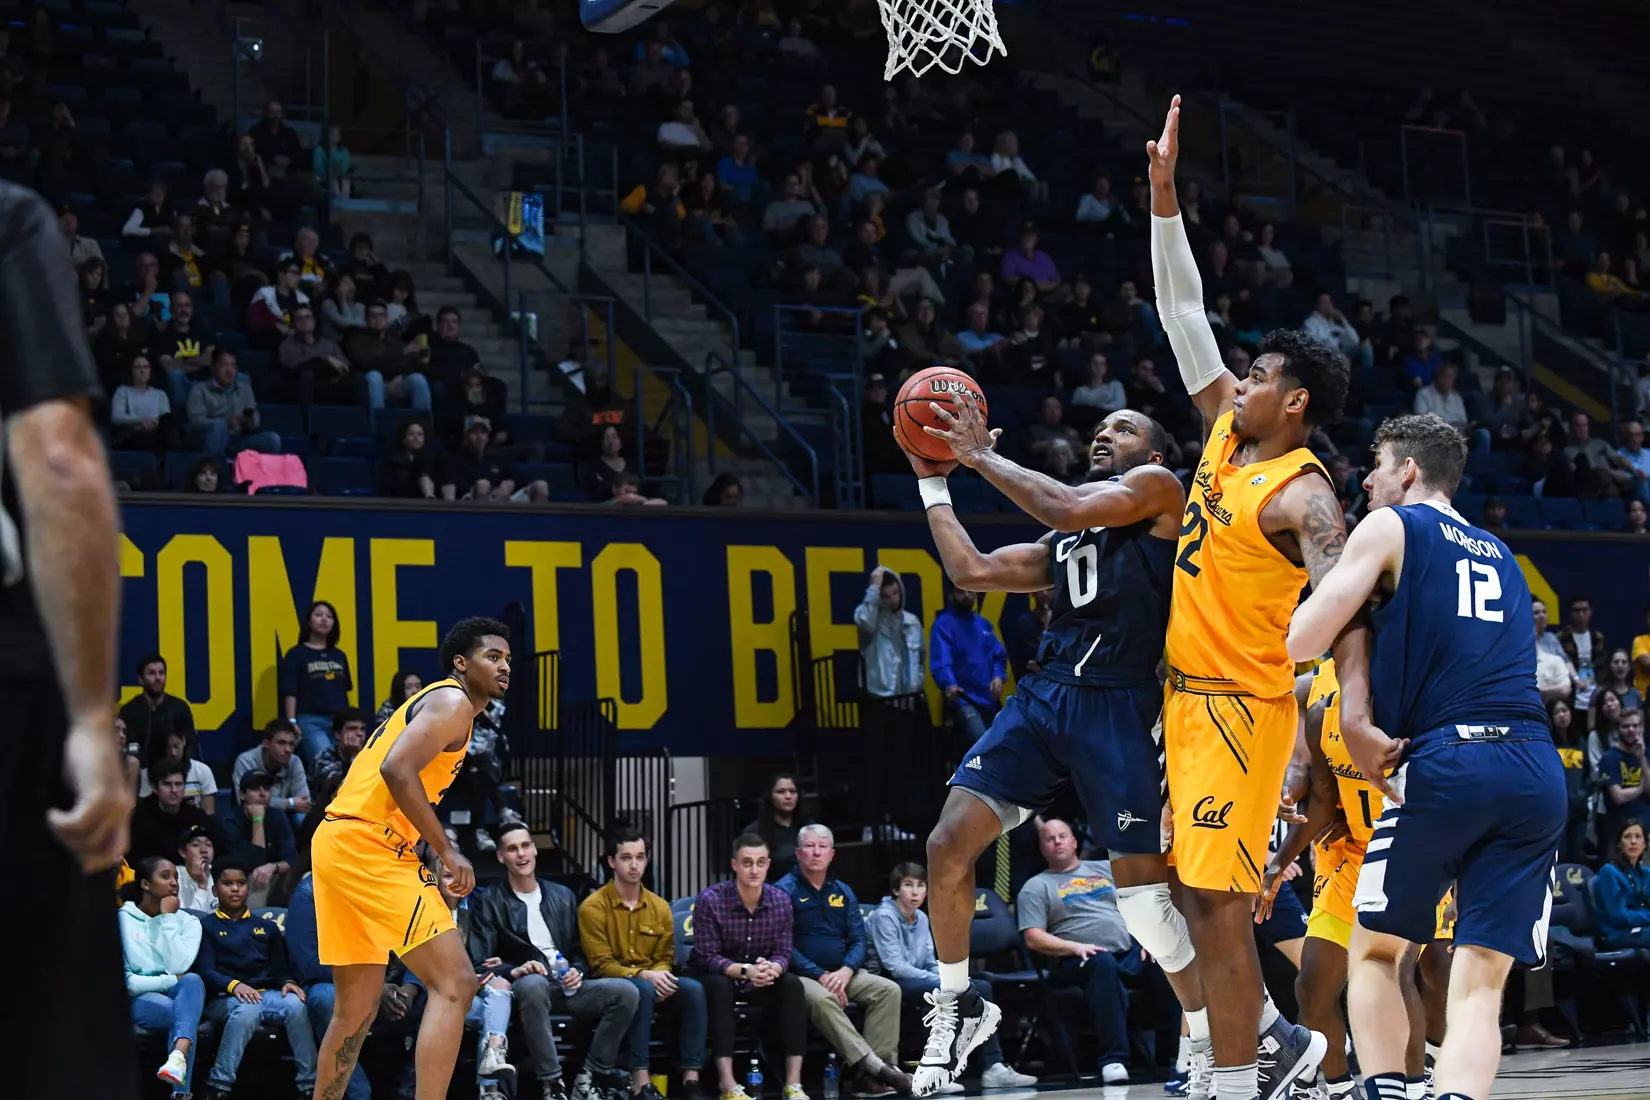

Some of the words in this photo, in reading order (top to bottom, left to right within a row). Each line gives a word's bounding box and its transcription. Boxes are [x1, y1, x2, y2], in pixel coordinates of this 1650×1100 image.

[929, 380, 985, 406] Wilon
[1067, 543, 1098, 609] 0
[1455, 558, 1504, 623] 12
[505, 540, 668, 730] TO
[1191, 795, 1234, 829] Cal
[418, 864, 437, 888] Ca
[827, 893, 845, 908] Cal
